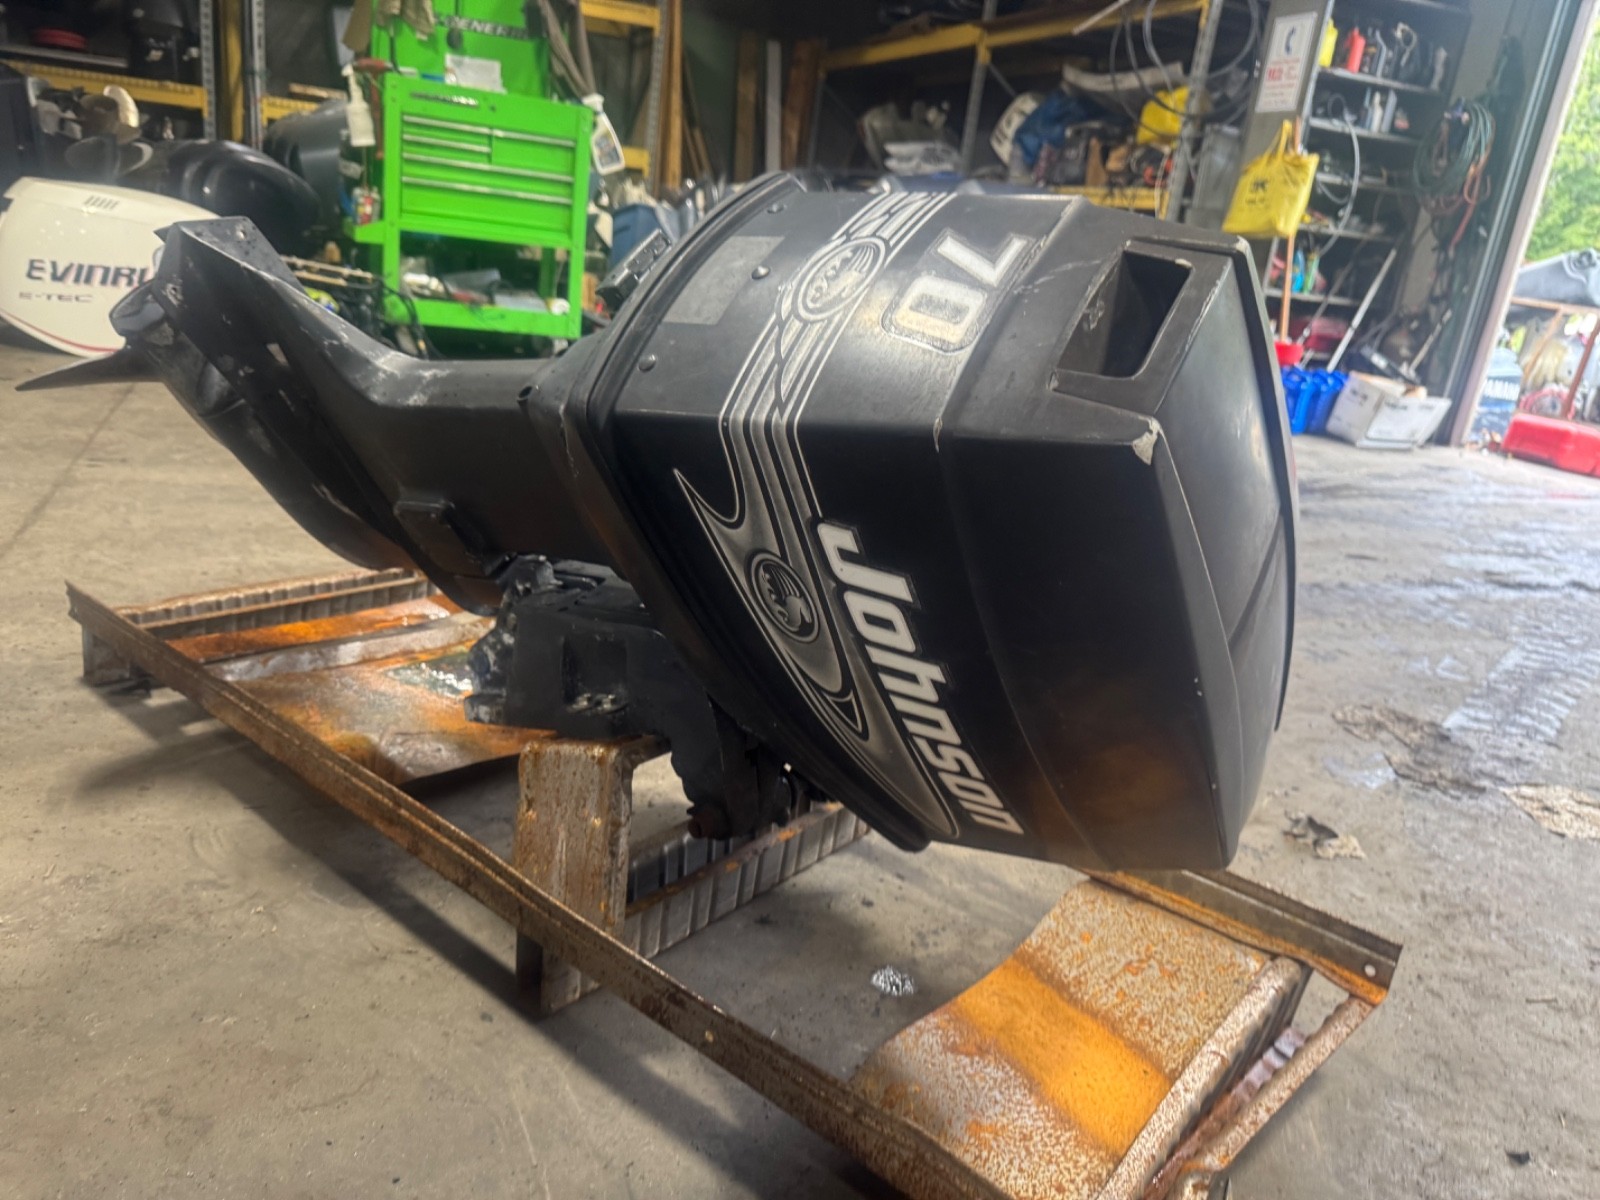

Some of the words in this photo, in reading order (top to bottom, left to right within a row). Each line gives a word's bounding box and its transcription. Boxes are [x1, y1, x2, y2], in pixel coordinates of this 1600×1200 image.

[19, 291, 93, 303] E-TEC
[887, 233, 1031, 348] 70
[816, 521, 1025, 835] Johnson
